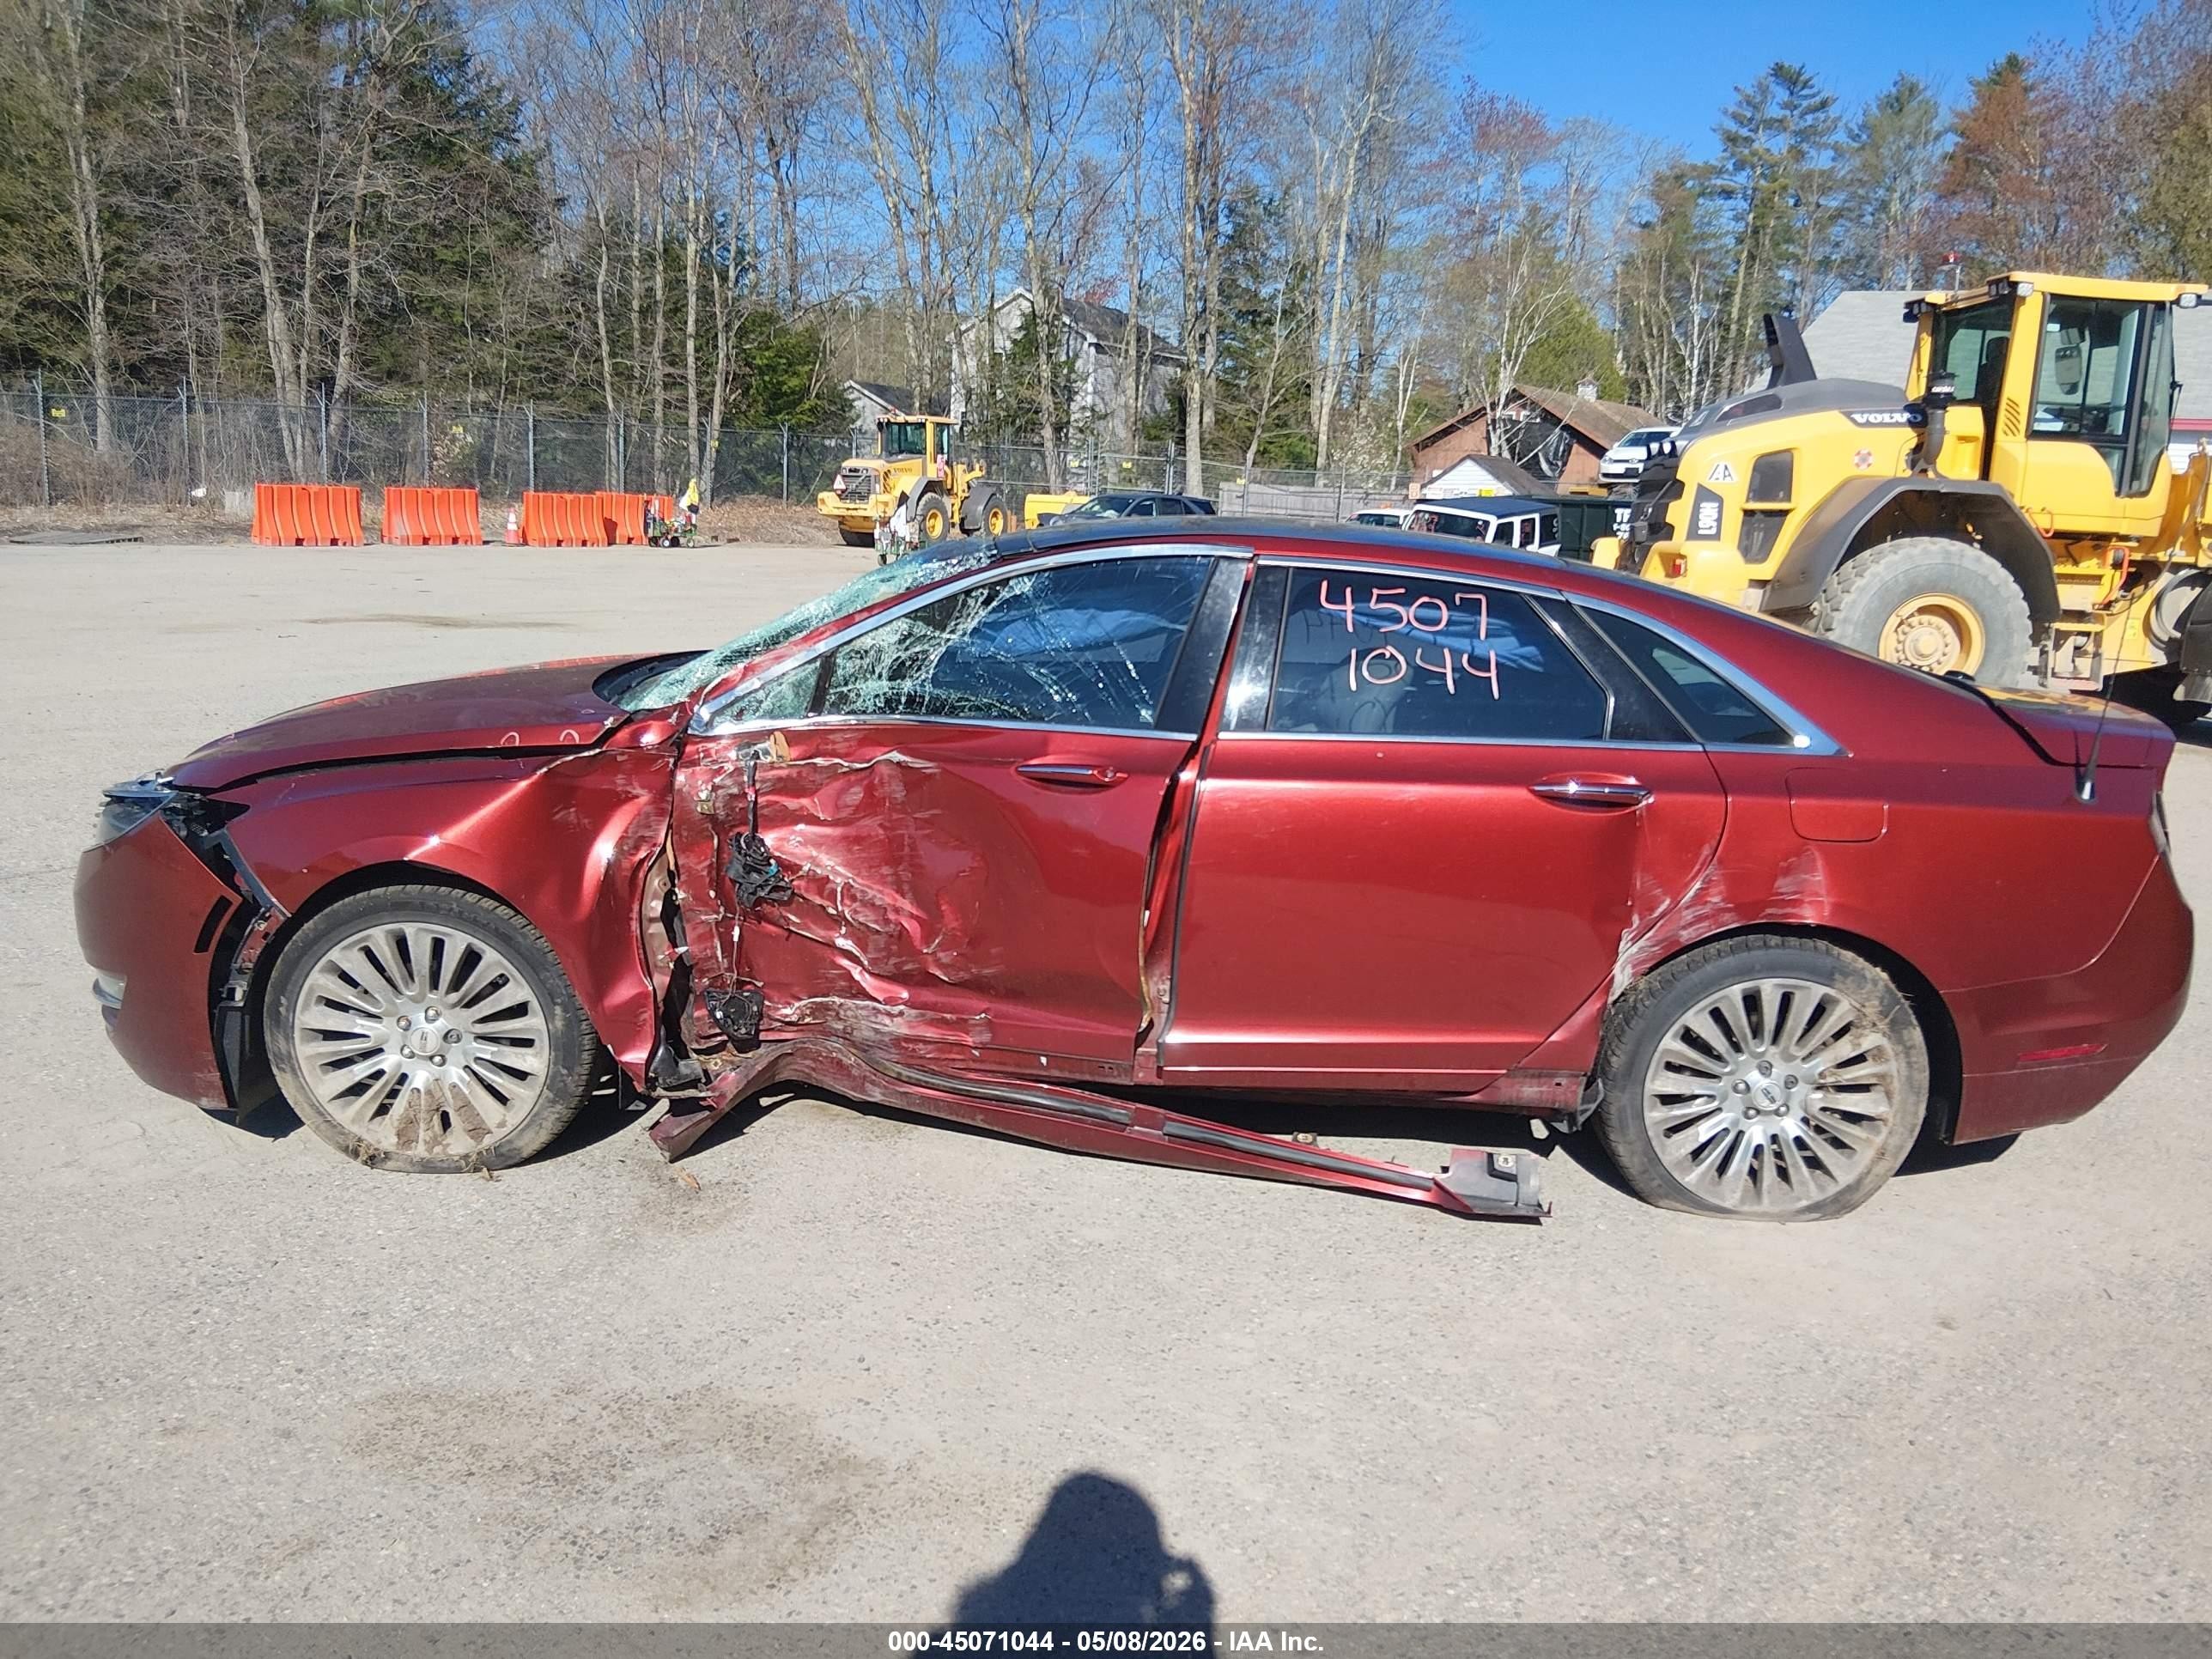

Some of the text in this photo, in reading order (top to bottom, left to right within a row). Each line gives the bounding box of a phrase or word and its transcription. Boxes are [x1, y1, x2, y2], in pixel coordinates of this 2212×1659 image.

[1850, 412, 1923, 424] VOLVO
[1697, 501, 1719, 535] L90H
[1319, 579, 1489, 641] 4507
[1347, 644, 1501, 701] 1044
